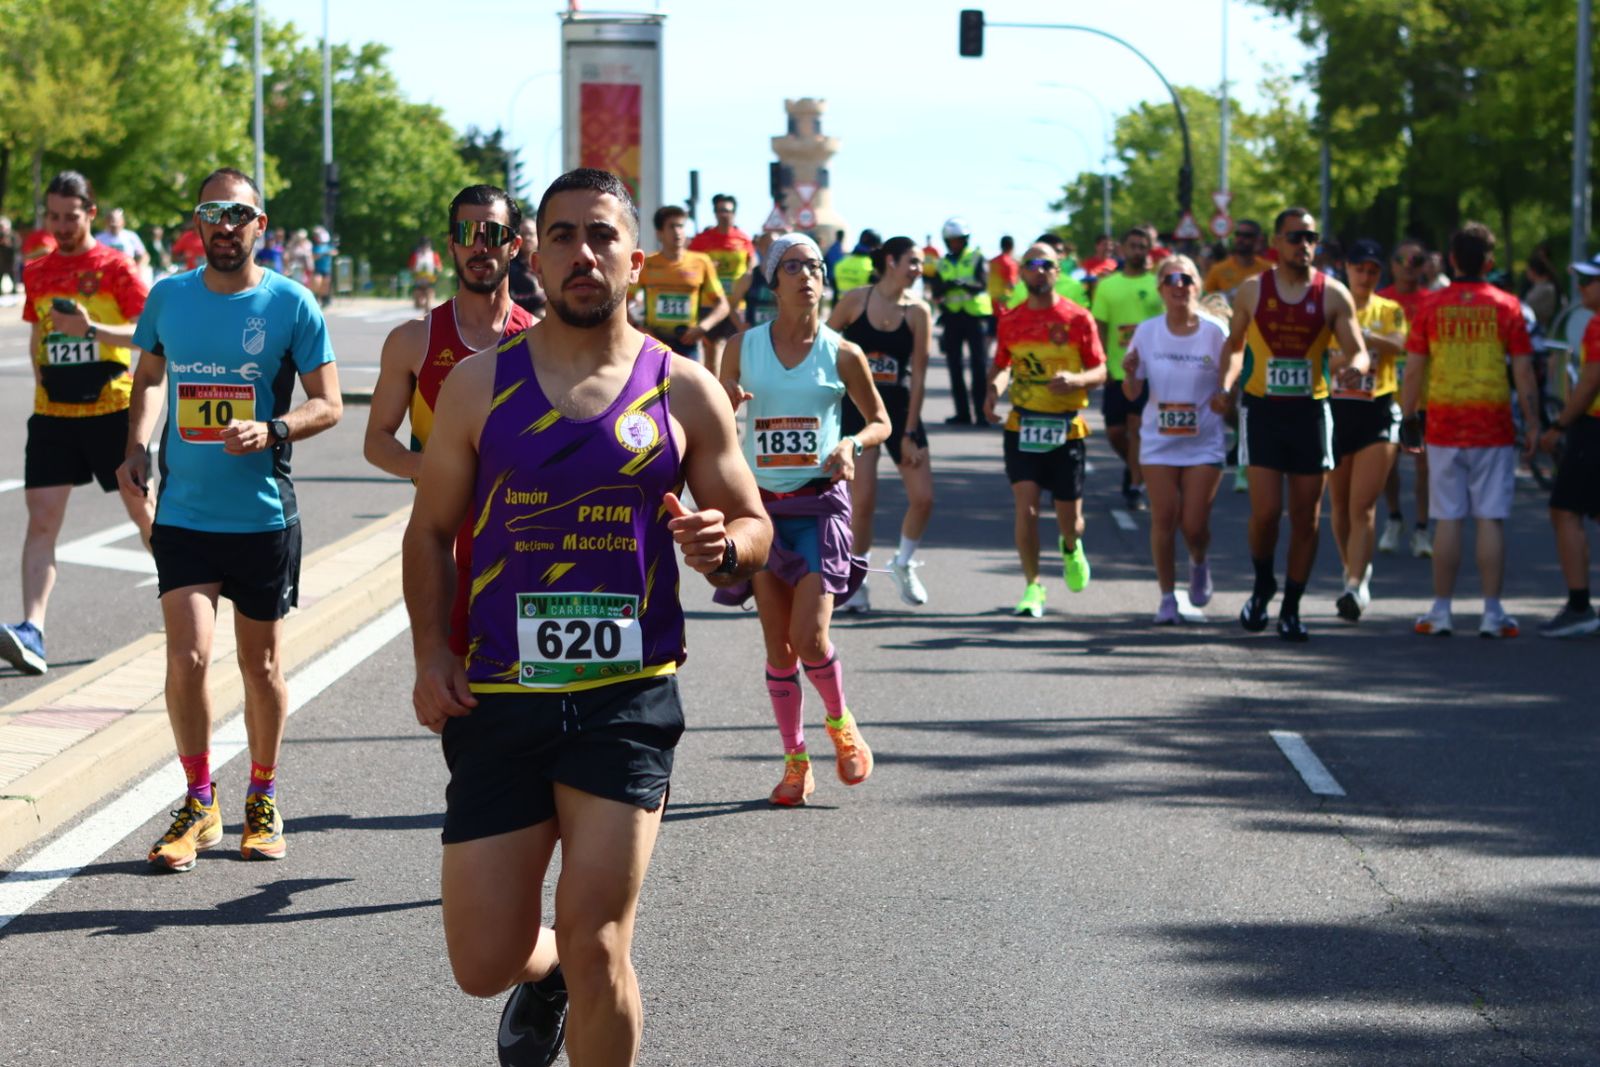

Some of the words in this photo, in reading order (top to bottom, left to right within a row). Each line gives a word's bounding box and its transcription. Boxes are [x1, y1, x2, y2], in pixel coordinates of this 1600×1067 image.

[50, 343, 94, 363] 1211
[1269, 370, 1309, 385] 1011
[179, 385, 196, 398] XIV
[198, 400, 233, 426] 10
[1159, 412, 1197, 427] 1822
[757, 431, 818, 454] 1833
[1022, 426, 1063, 444] 1147
[504, 488, 549, 505] Jamón
[577, 505, 632, 524] PRIM
[514, 540, 555, 552] Atletismo
[562, 533, 638, 552] Macotera
[551, 604, 605, 616] CARRERA
[536, 620, 622, 660] 620
